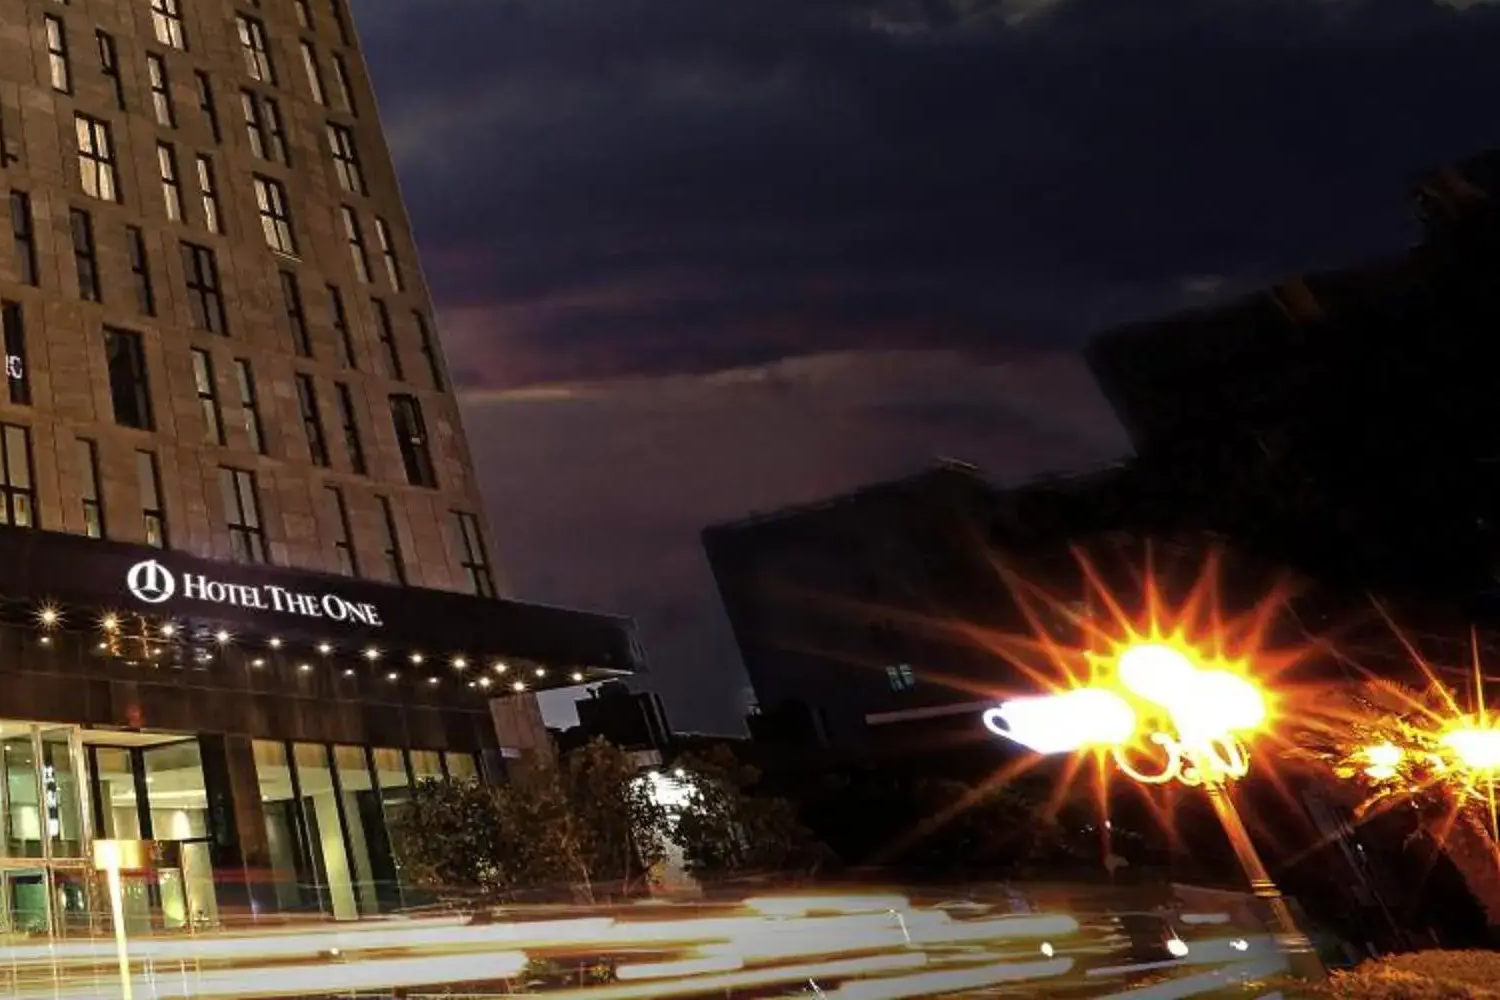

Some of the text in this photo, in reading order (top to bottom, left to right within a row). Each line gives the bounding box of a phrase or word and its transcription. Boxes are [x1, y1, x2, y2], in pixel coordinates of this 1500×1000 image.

[183, 572, 384, 628] HOTEL THE ONE
